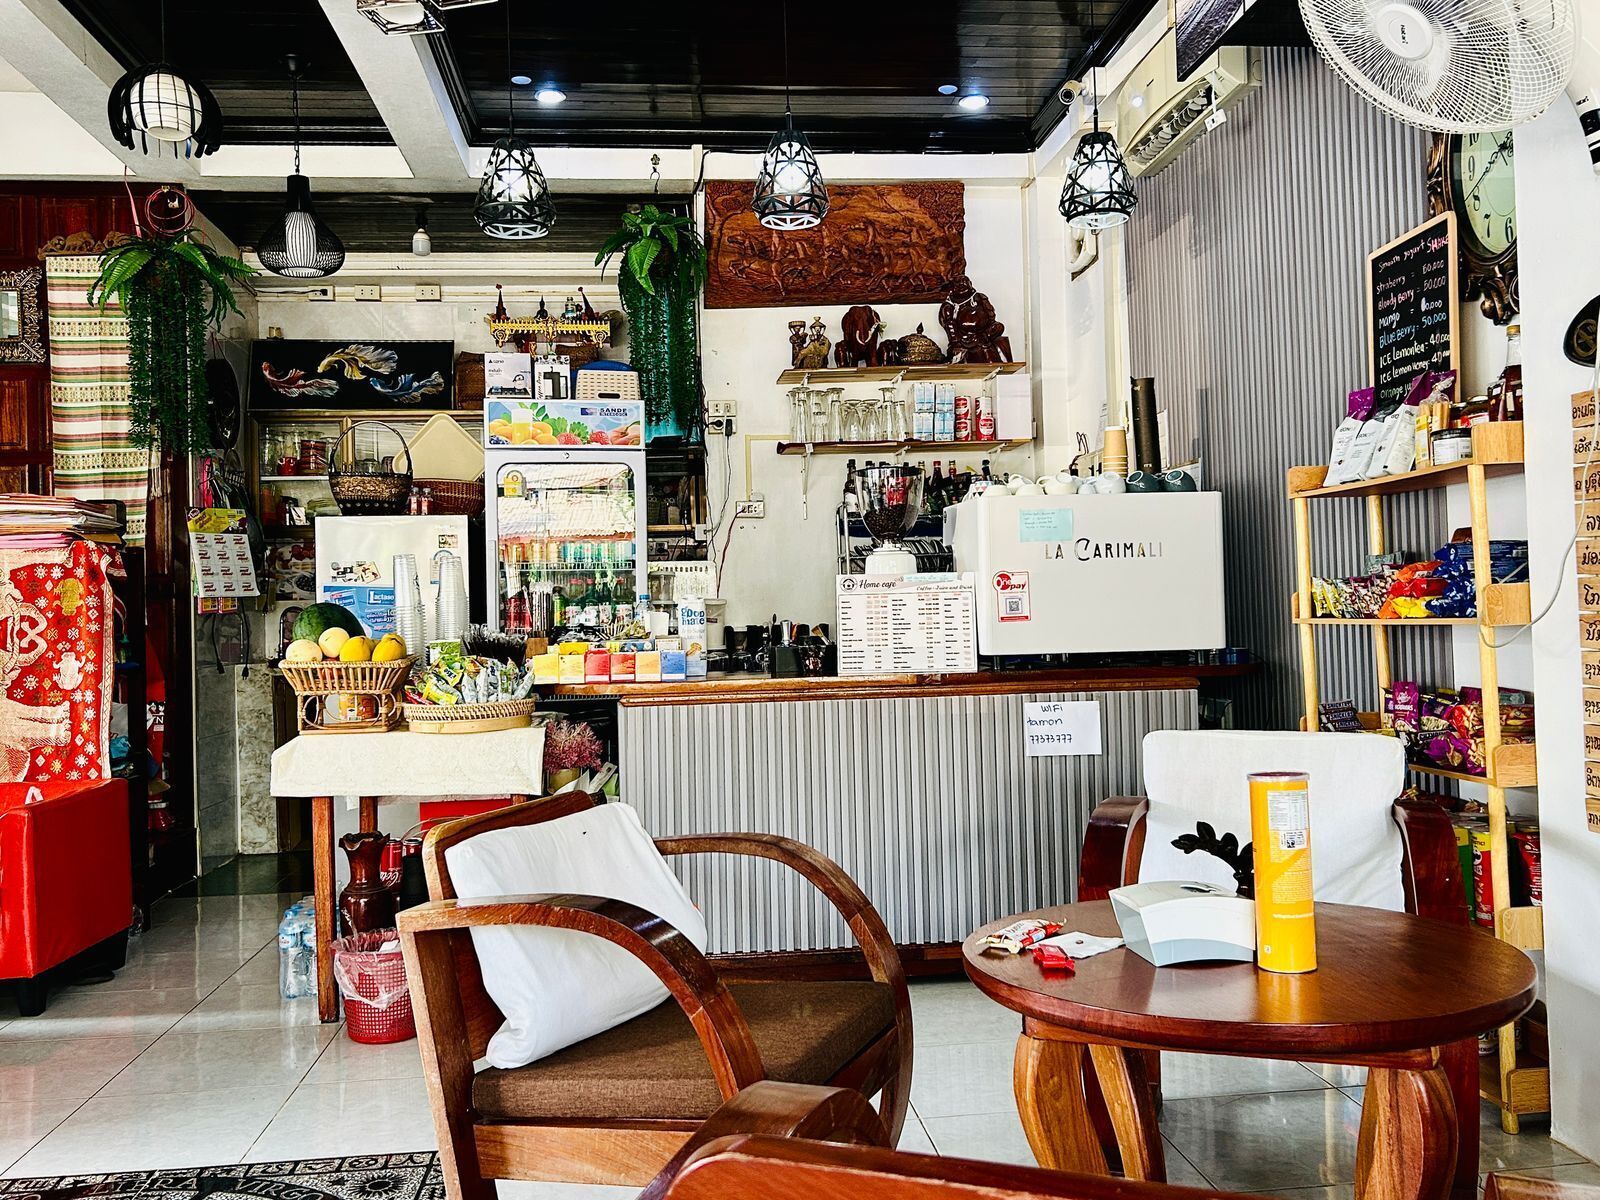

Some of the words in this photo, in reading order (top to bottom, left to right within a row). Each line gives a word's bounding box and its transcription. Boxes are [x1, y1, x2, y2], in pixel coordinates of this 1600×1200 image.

[1468, 156, 1475, 181] 9
[1505, 217, 1514, 243] 6
[1380, 353, 1392, 368] ICE
[1380, 371, 1392, 384] ICE
[1044, 544, 1064, 559] LA
[1074, 538, 1162, 561] CARIMALI
